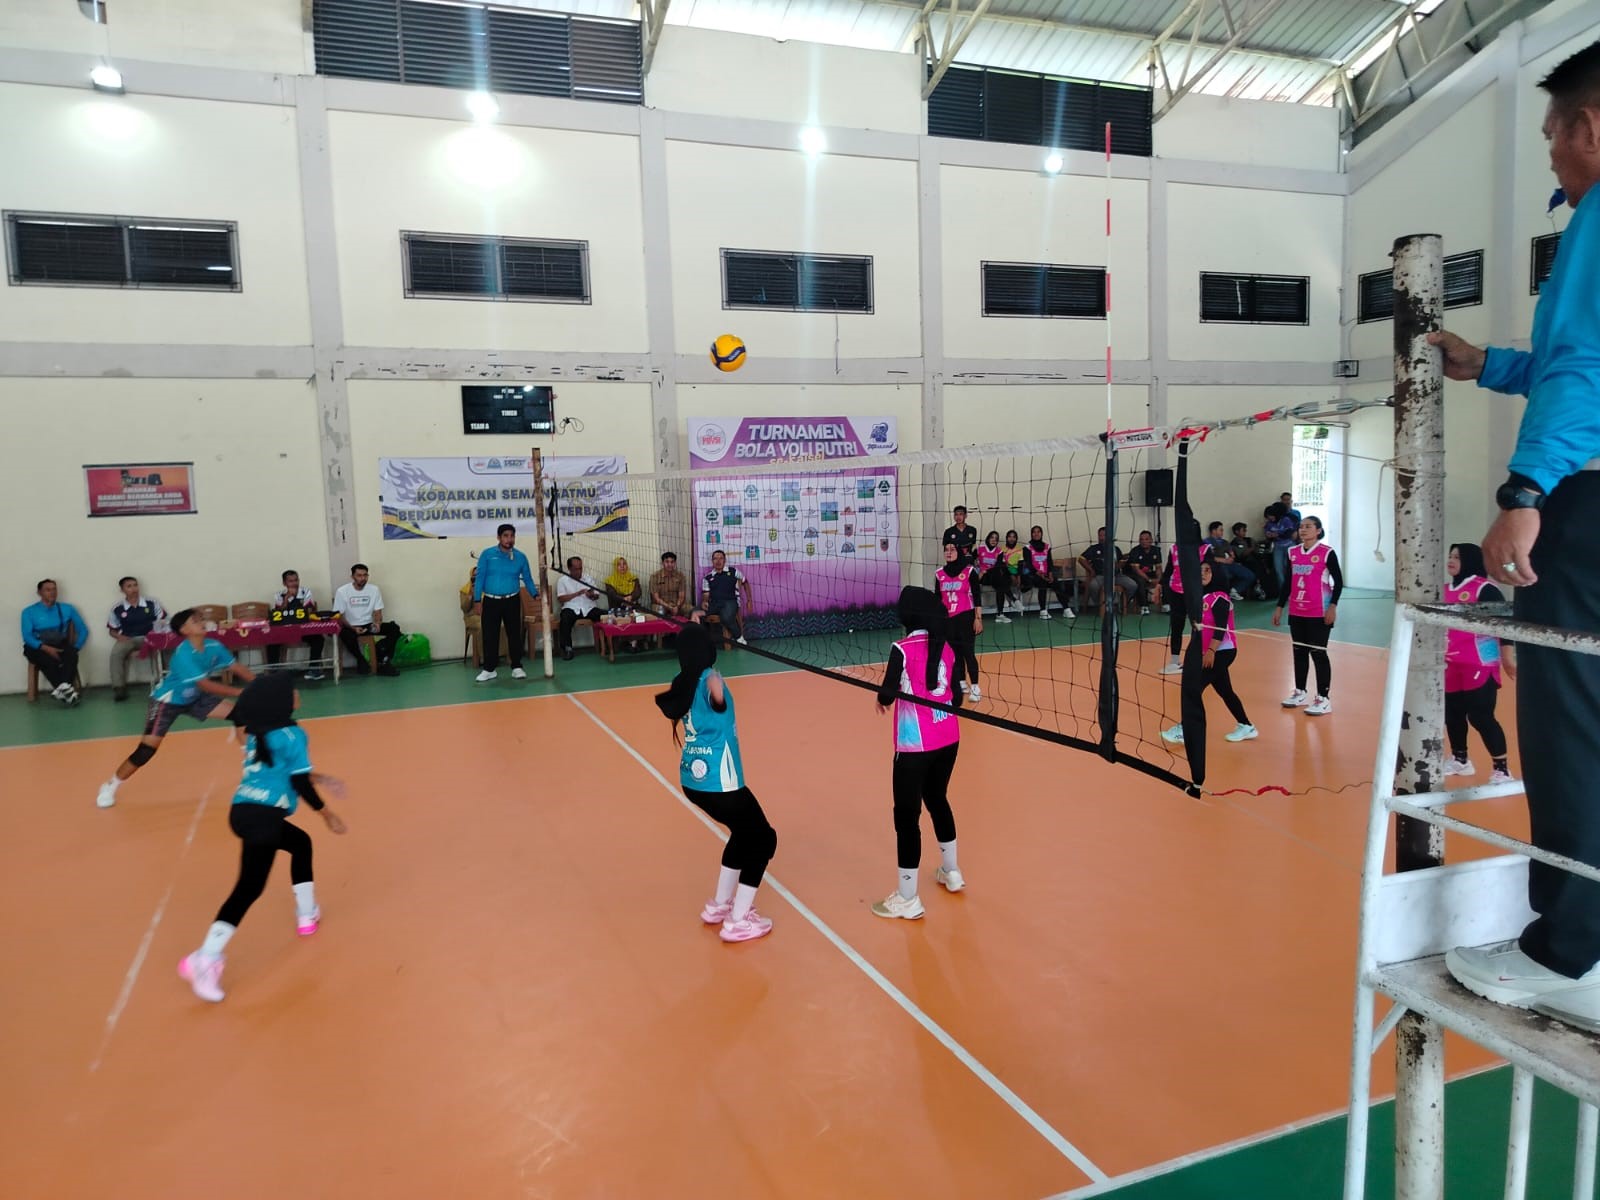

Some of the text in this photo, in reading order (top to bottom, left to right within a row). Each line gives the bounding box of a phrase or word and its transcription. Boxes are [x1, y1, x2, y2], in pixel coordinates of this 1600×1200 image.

[748, 424, 845, 441] TURNAMEN
[734, 443, 779, 458] BOLA
[779, 441, 812, 457] VOLI
[815, 441, 858, 456] PUTRI
[416, 488, 497, 502] KOBARKAN
[398, 505, 615, 521] BERJUANG DEMI HAI TERBAIK
[273, 611, 282, 621] 2
[296, 608, 305, 619] 5
